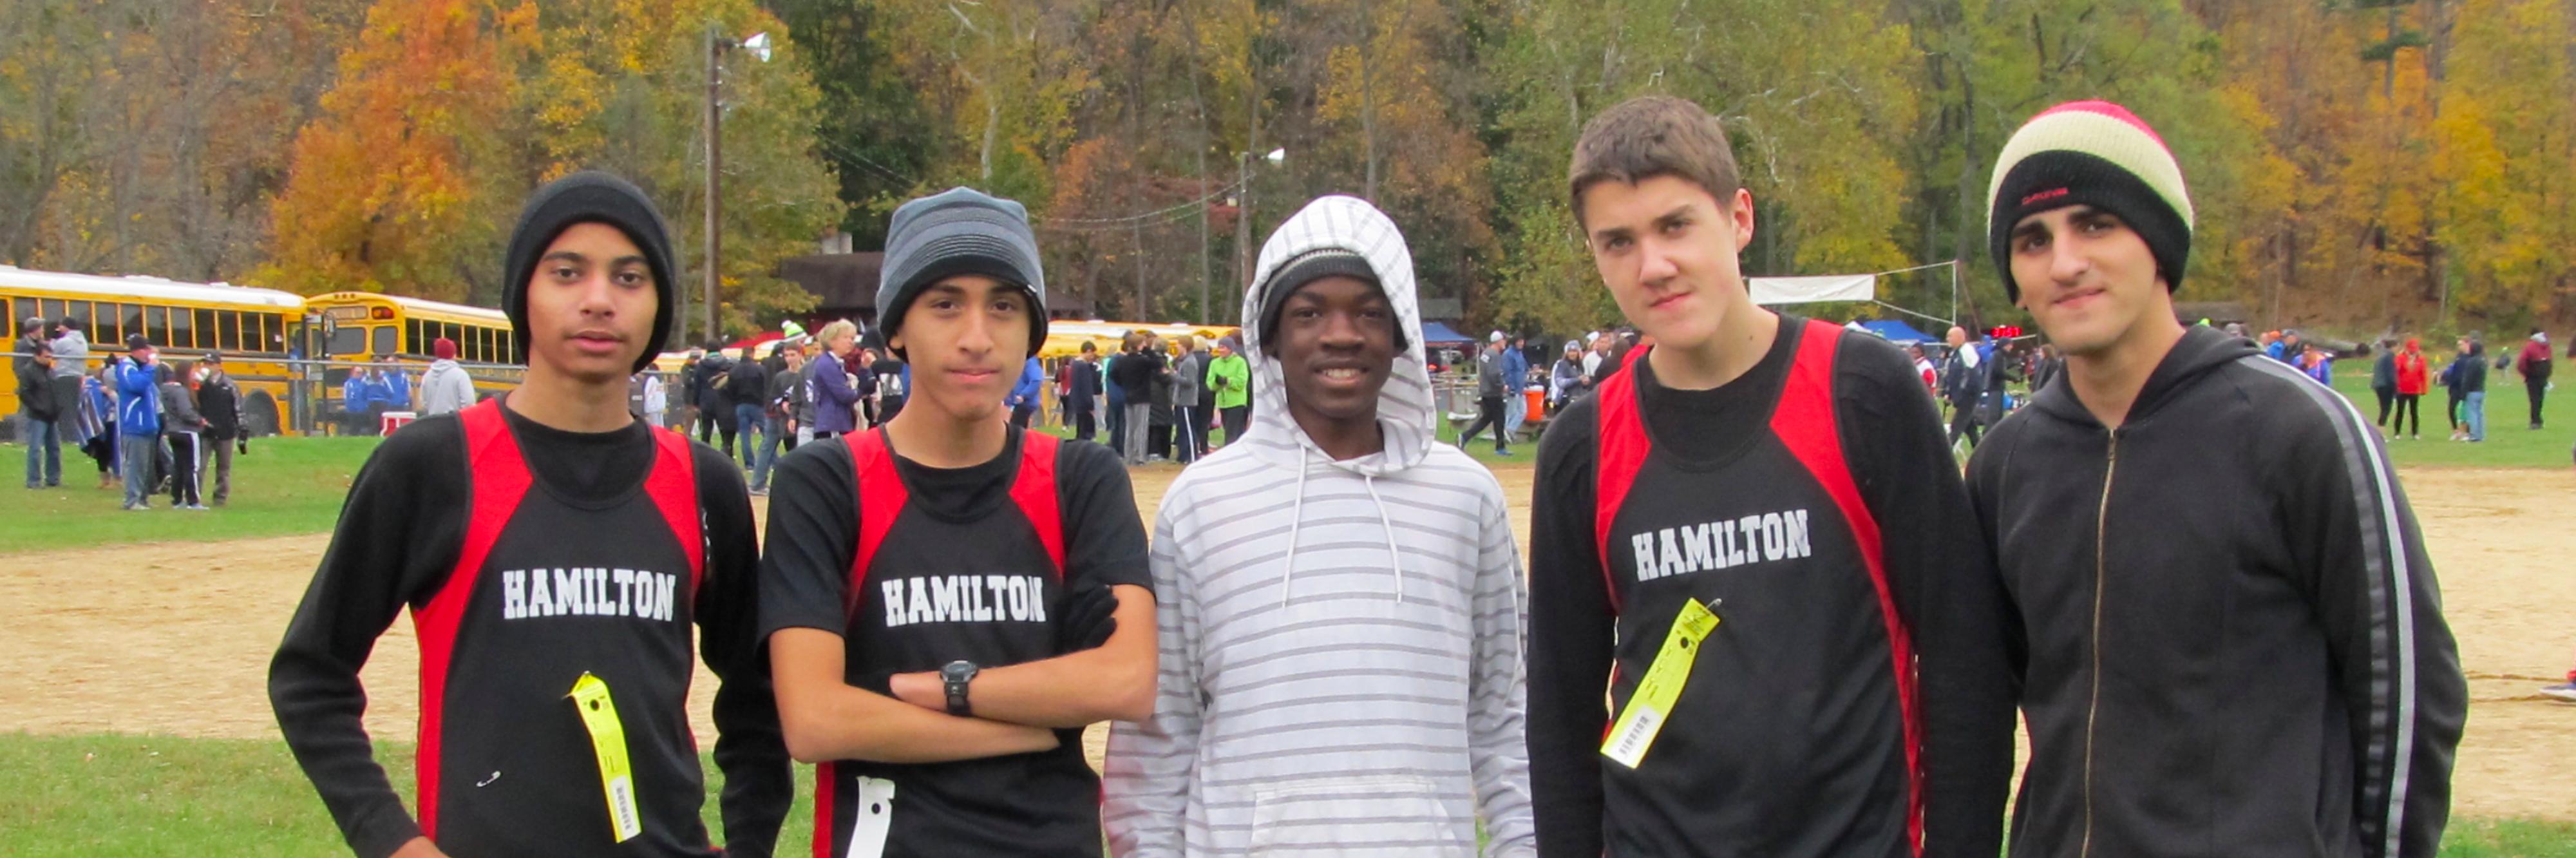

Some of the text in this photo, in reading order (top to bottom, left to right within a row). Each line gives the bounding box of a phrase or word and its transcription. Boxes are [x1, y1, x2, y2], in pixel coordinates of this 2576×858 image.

[1631, 509, 1812, 582] HAMILTON
[502, 567, 676, 622] HAMILTON
[881, 574, 1046, 627] HAMILTON
